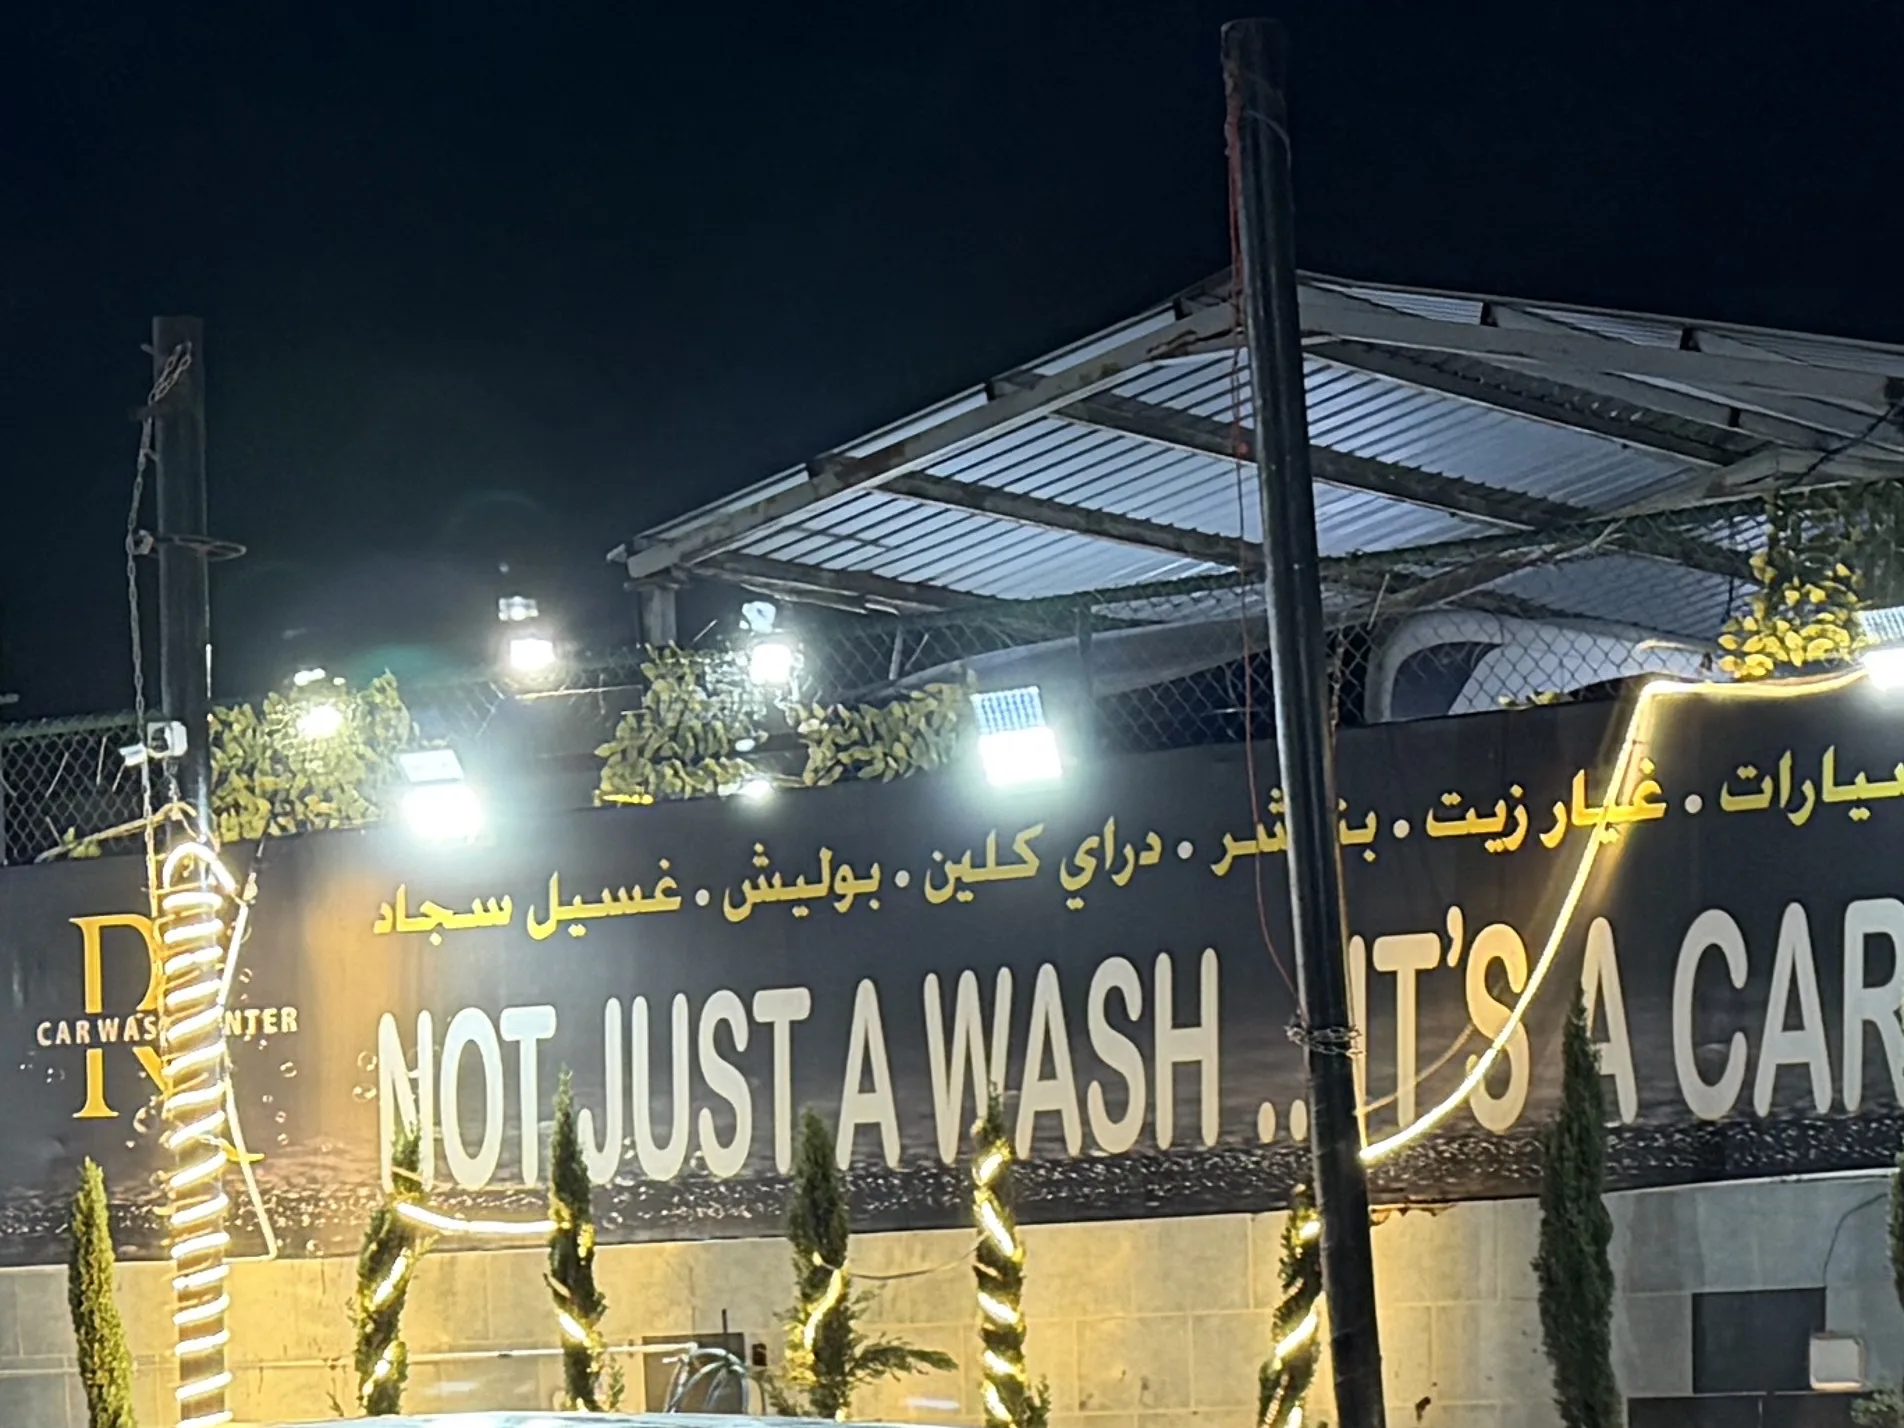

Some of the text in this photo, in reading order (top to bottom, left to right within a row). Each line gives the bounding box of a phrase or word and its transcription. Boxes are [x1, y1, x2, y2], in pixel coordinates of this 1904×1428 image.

[1424, 785, 1530, 853] زيت
[526, 859, 682, 940] غسيل
[723, 842, 881, 922] بوليش
[923, 824, 1044, 903] كلين
[1059, 816, 1162, 909] دراي
[372, 884, 513, 946] سجاد
[378, 1005, 556, 1193] NOT
[577, 986, 812, 1185] JUST
[835, 978, 901, 1171] A
[924, 947, 1219, 1166] WASH
[1349, 905, 1530, 1135] IT'S
[1580, 916, 1638, 1125] A
